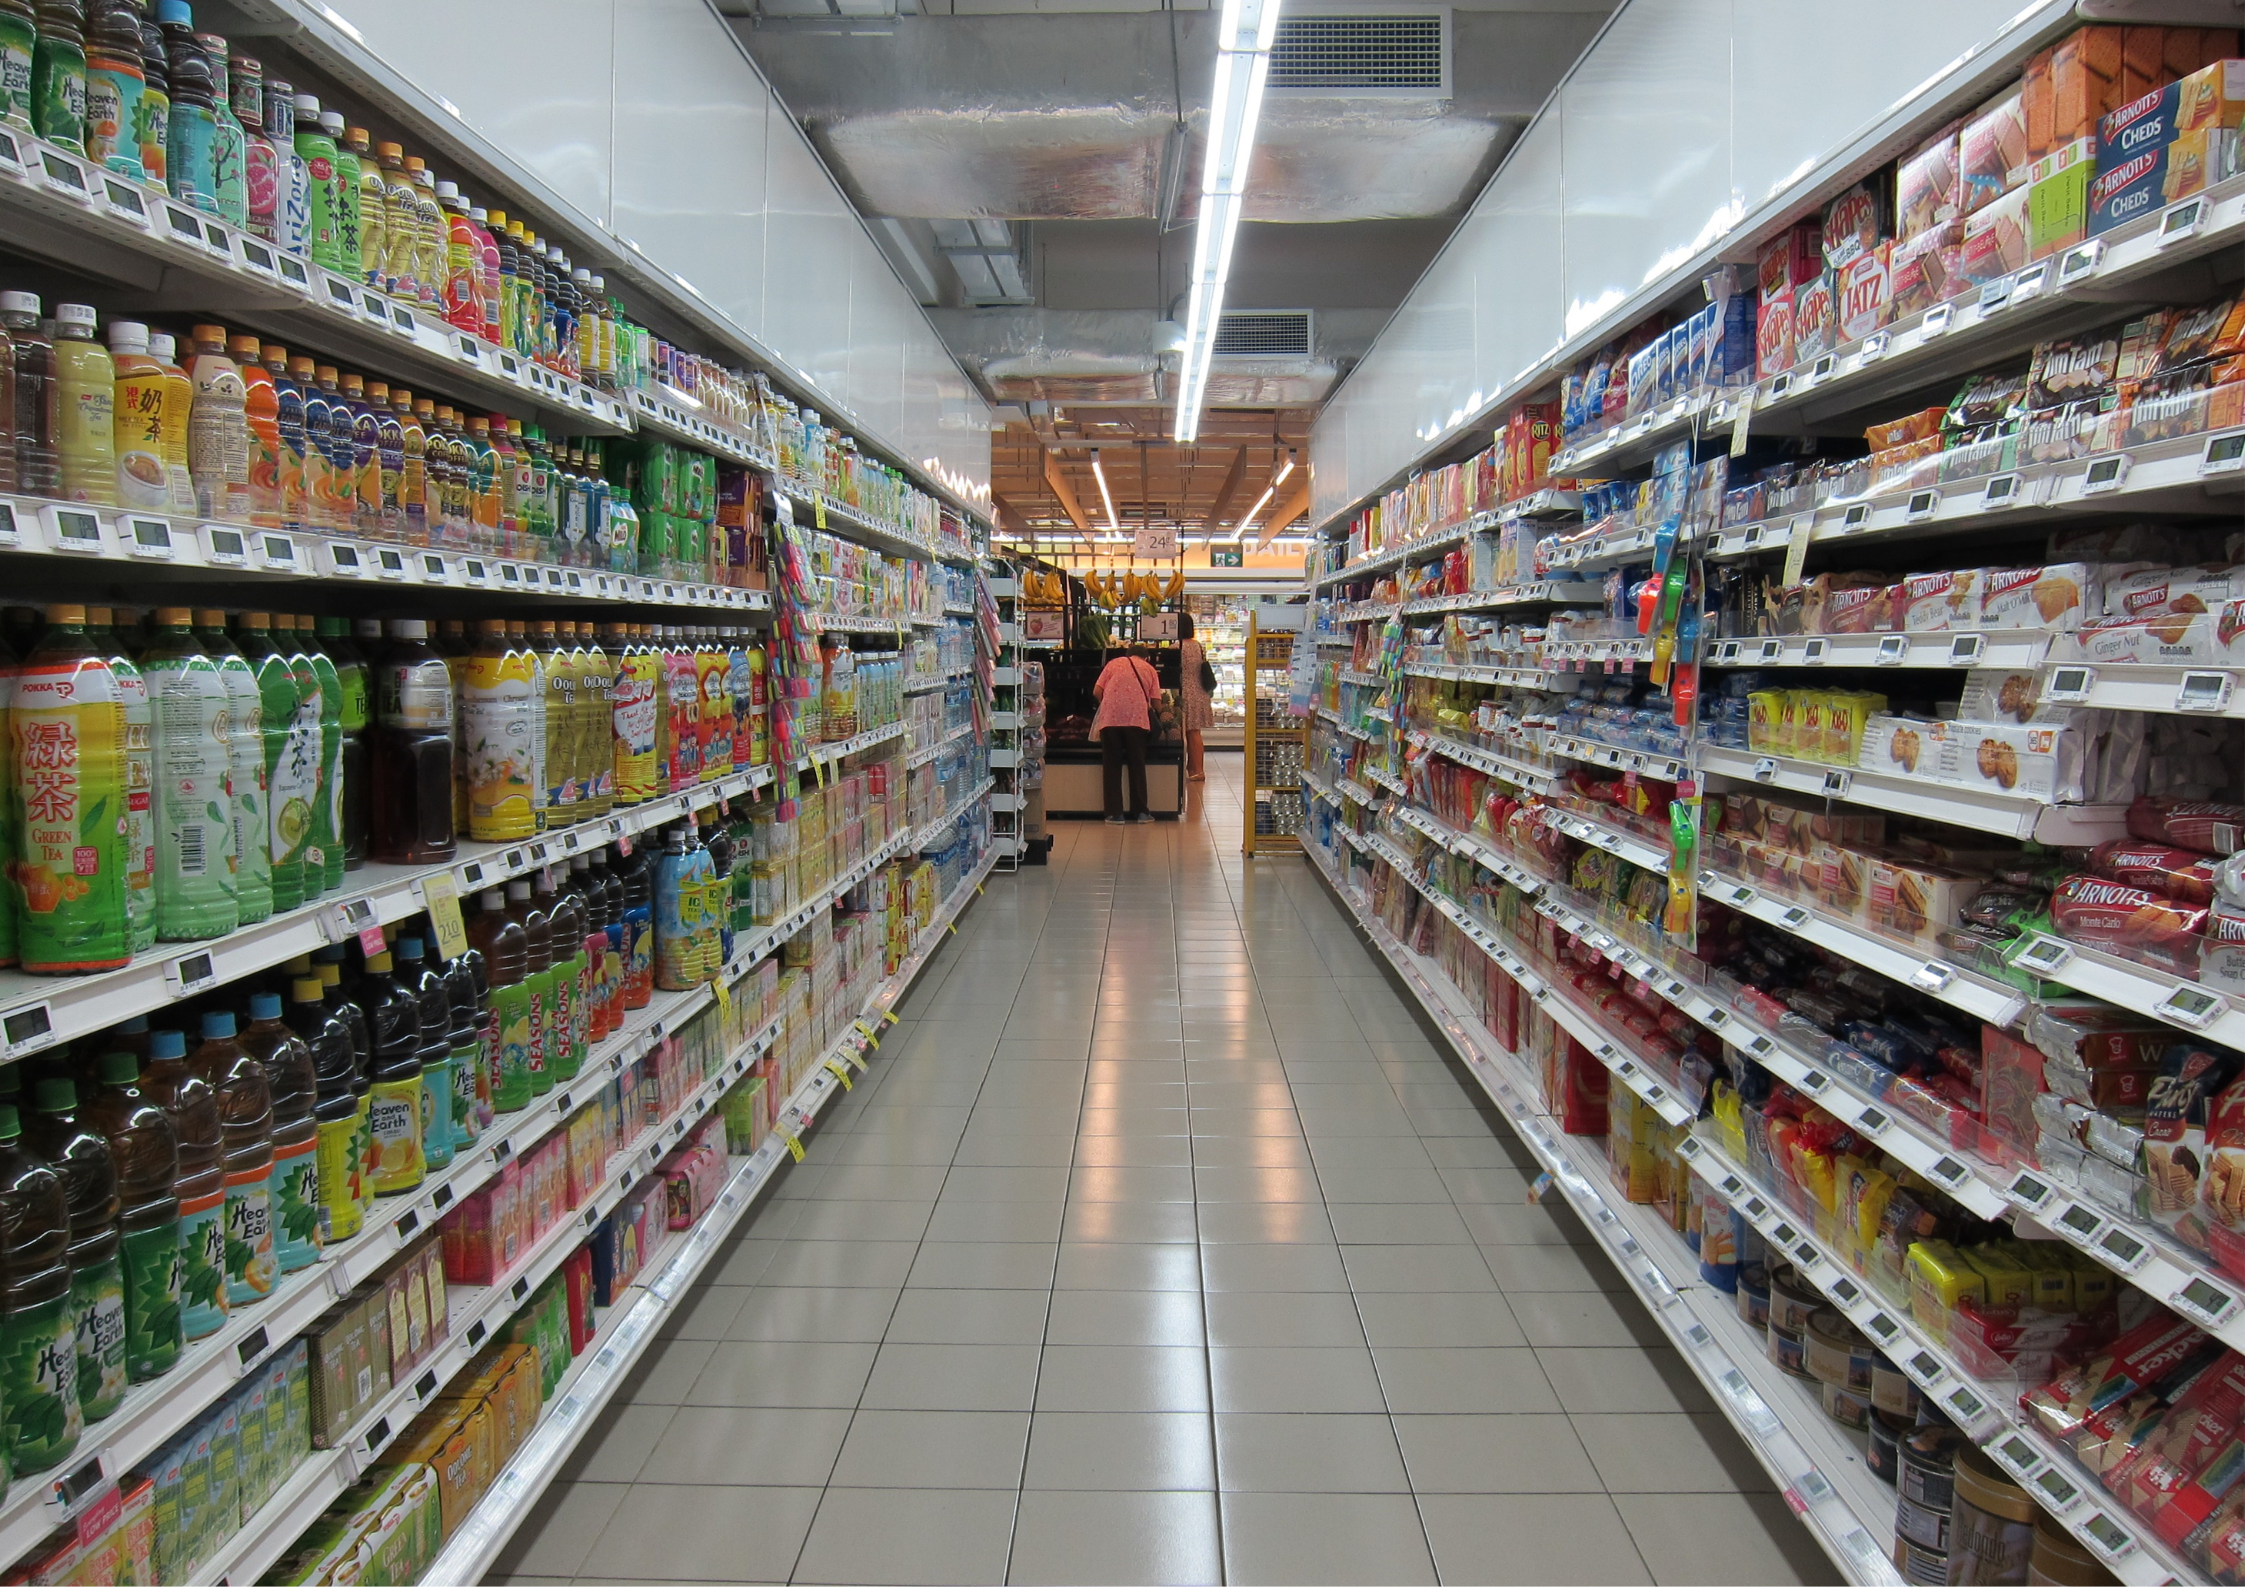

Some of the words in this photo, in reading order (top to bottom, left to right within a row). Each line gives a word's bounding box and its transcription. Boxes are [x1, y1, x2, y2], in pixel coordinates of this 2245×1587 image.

[2121, 118, 2162, 150] CHEDS
[2111, 188, 2150, 218] CHEDS
[1843, 273, 1882, 325] JATZ
[1630, 355, 1653, 392] OREO
[138, 388, 163, 443] 奶茶
[1532, 424, 1549, 437] RITZ
[1931, 608, 1944, 621] Bear
[2095, 638, 2121, 656] Ginger
[2123, 633, 2140, 648] Nut
[22, 682, 54, 693] POKKA
[32, 828, 72, 845] GREEN
[43, 846, 64, 863] TEA
[2080, 915, 2100, 929] Monte
[2101, 917, 2121, 930] Carlo
[2220, 967, 2234, 981] Snap
[557, 980, 572, 1058] SEASONS
[529, 993, 544, 1072] SEASONS
[371, 1116, 407, 1135] Earth
[447, 1443, 473, 1482] OOLONG
[454, 1468, 467, 1490] TEA
[86, 1523, 103, 1540] LOW
[101, 1504, 121, 1528] PRICE
